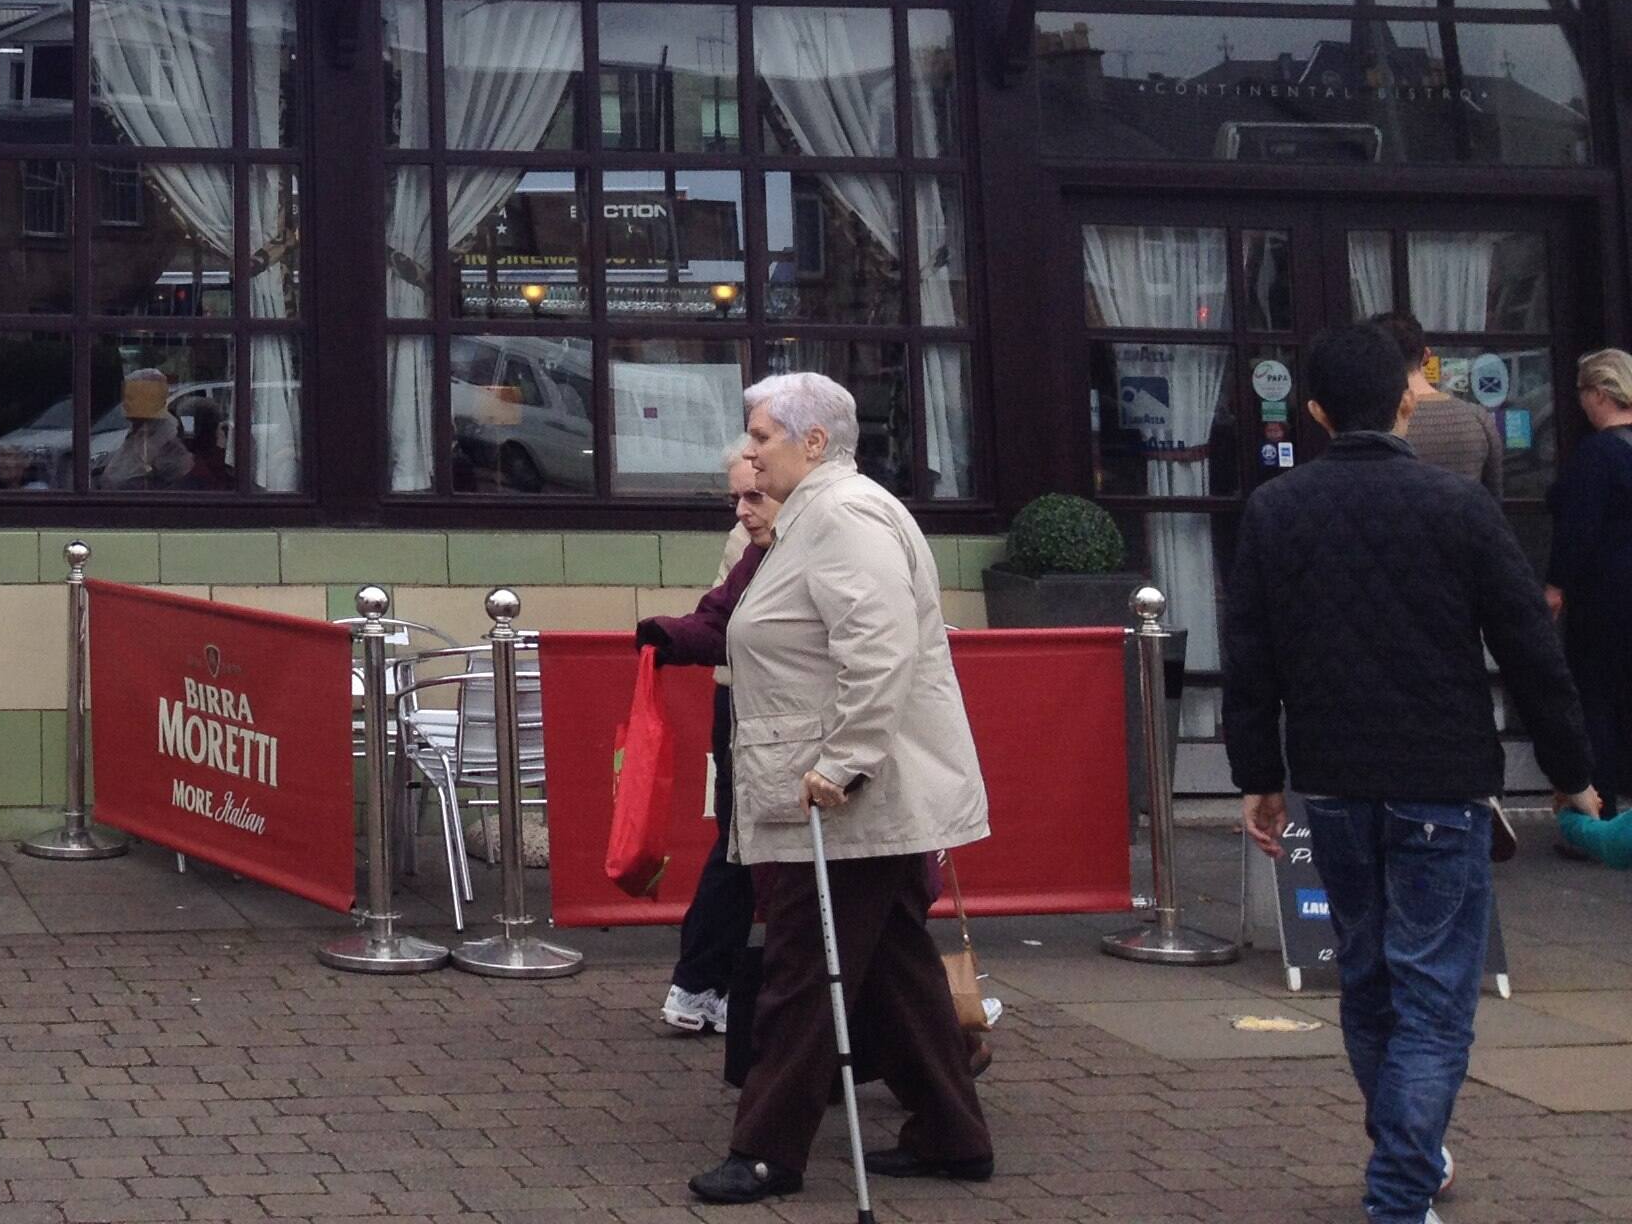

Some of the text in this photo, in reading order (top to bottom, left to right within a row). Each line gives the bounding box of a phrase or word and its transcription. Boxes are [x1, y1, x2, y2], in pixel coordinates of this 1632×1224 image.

[1154, 81, 1472, 101] CONTINENTAL BISTRO
[184, 676, 254, 725] BIRRA
[158, 696, 278, 787] MORETTI
[172, 778, 266, 836] MORE Italian
